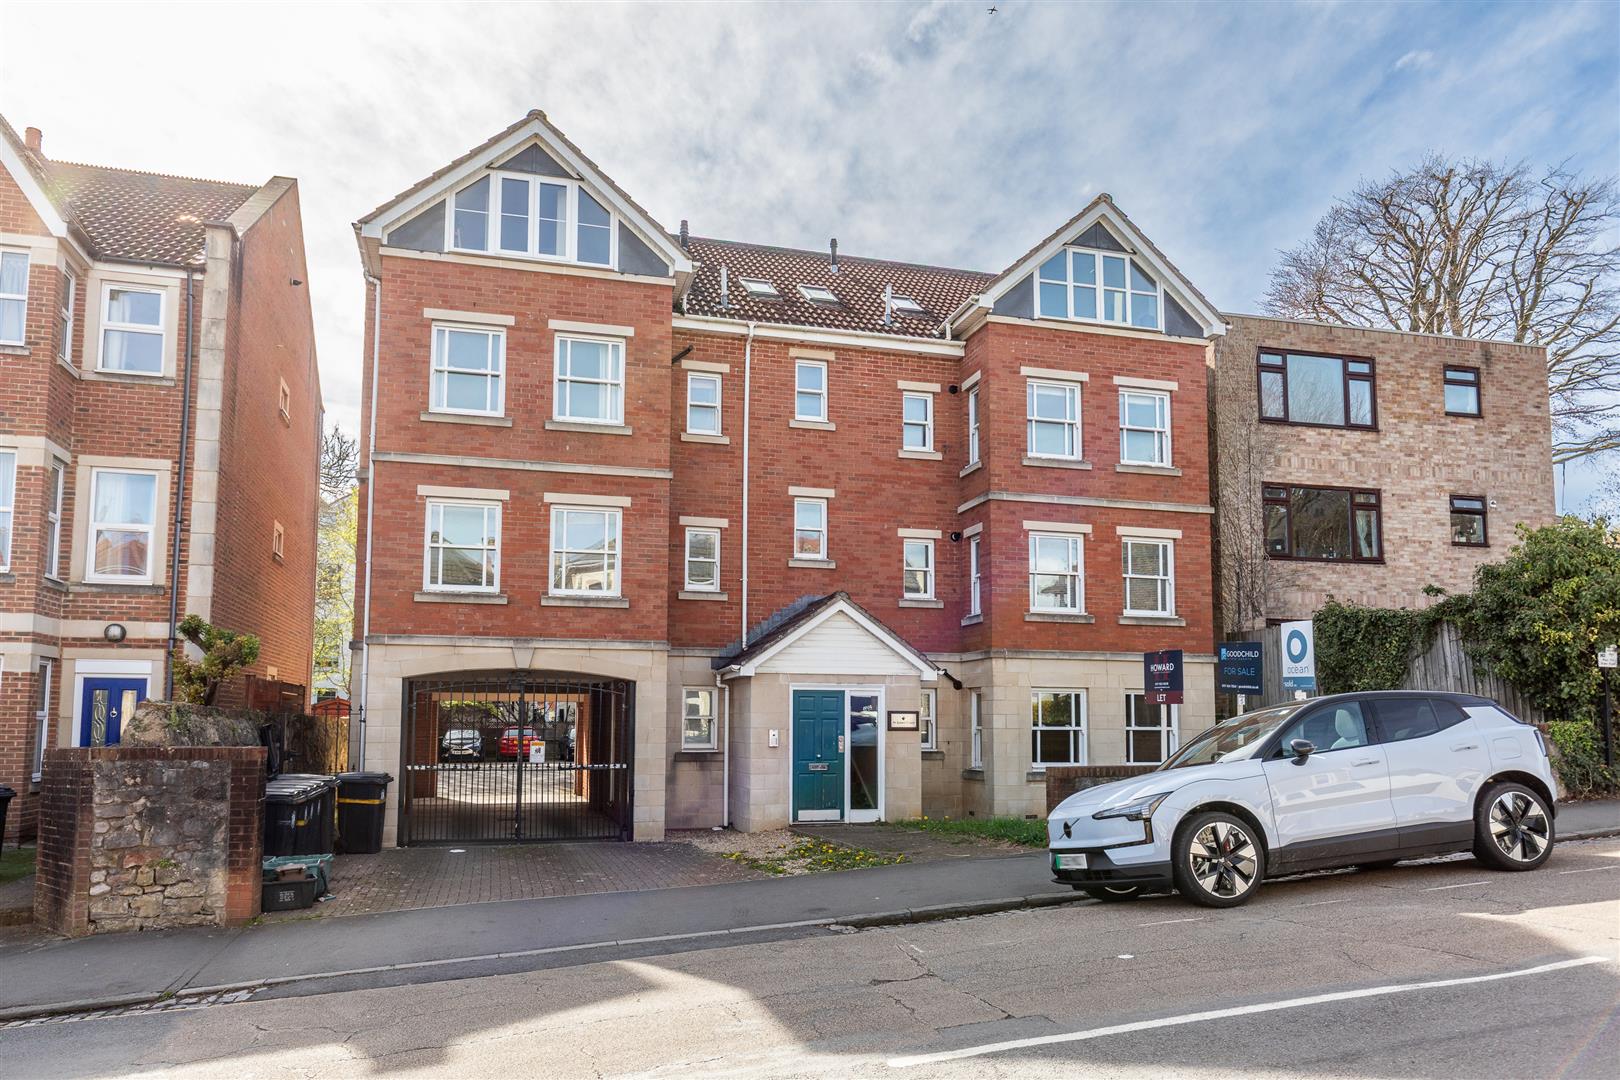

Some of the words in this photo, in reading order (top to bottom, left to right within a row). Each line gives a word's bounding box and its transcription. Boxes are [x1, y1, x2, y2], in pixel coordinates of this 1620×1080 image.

[1226, 650, 1259, 658] GOODCHILD
[1150, 662, 1175, 672] HOWARD
[1223, 667, 1237, 676] FOR
[1237, 667, 1256, 676] SALE
[1287, 665, 1309, 674] ocean
[1156, 693, 1167, 702] LET
